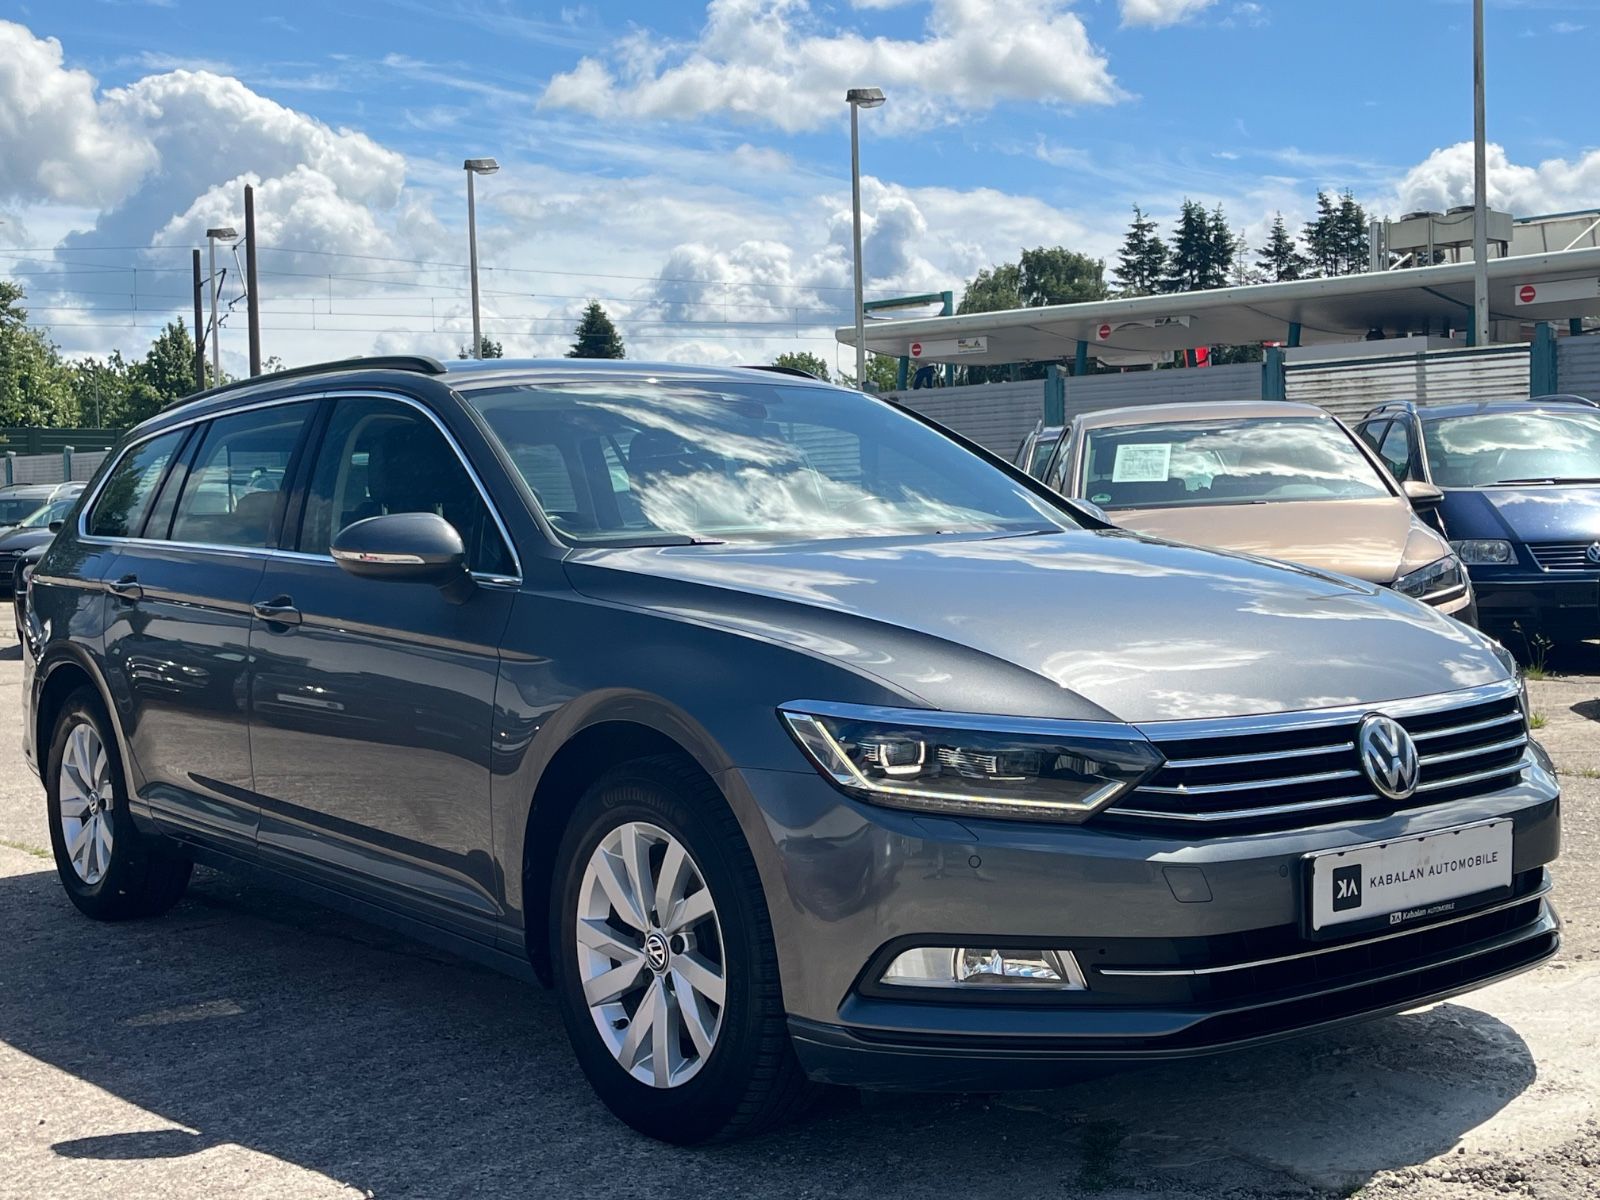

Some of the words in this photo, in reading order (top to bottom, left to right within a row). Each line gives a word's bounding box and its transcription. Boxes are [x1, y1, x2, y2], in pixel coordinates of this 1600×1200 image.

[1369, 867, 1424, 888] KABALAN
[1428, 851, 1498, 876] AUTOMOBILE
[1402, 909, 1427, 920] Kabalan
